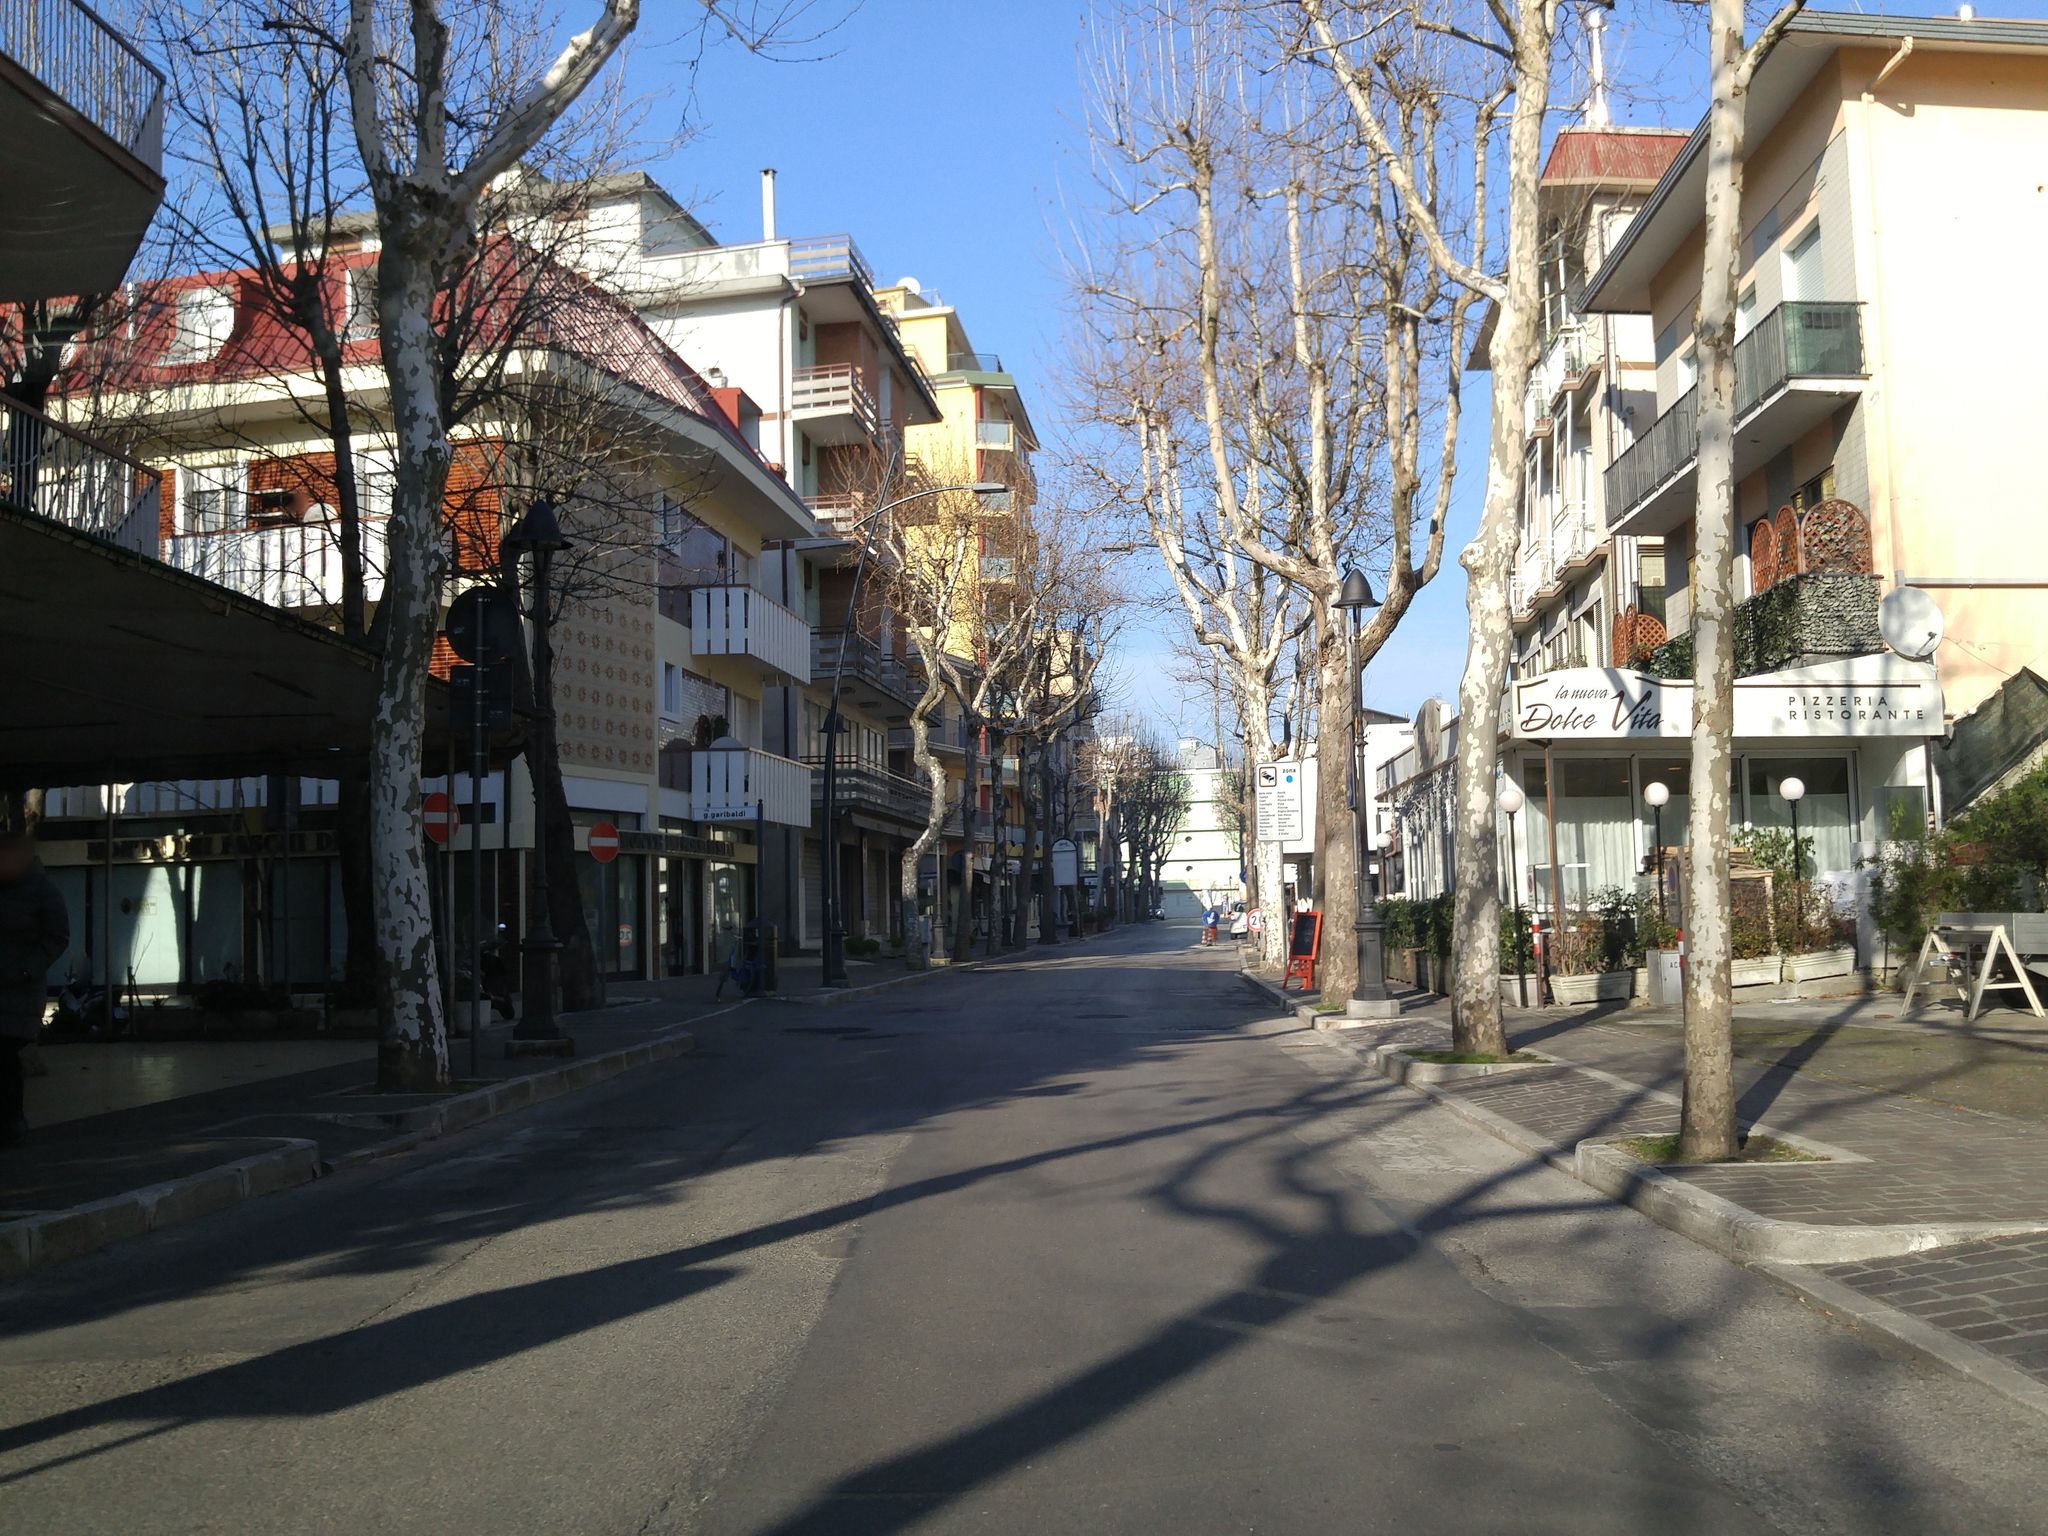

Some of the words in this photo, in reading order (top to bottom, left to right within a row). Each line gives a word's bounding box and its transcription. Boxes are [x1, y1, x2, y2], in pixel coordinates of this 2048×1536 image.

[1555, 684, 1569, 699] la
[1571, 688, 1608, 699] nuova
[1788, 696, 1888, 706] PIZZERIA
[1520, 703, 1597, 732] Dolce
[1610, 689, 1664, 732] Vita
[1789, 710, 1924, 720] RISTORANTE
